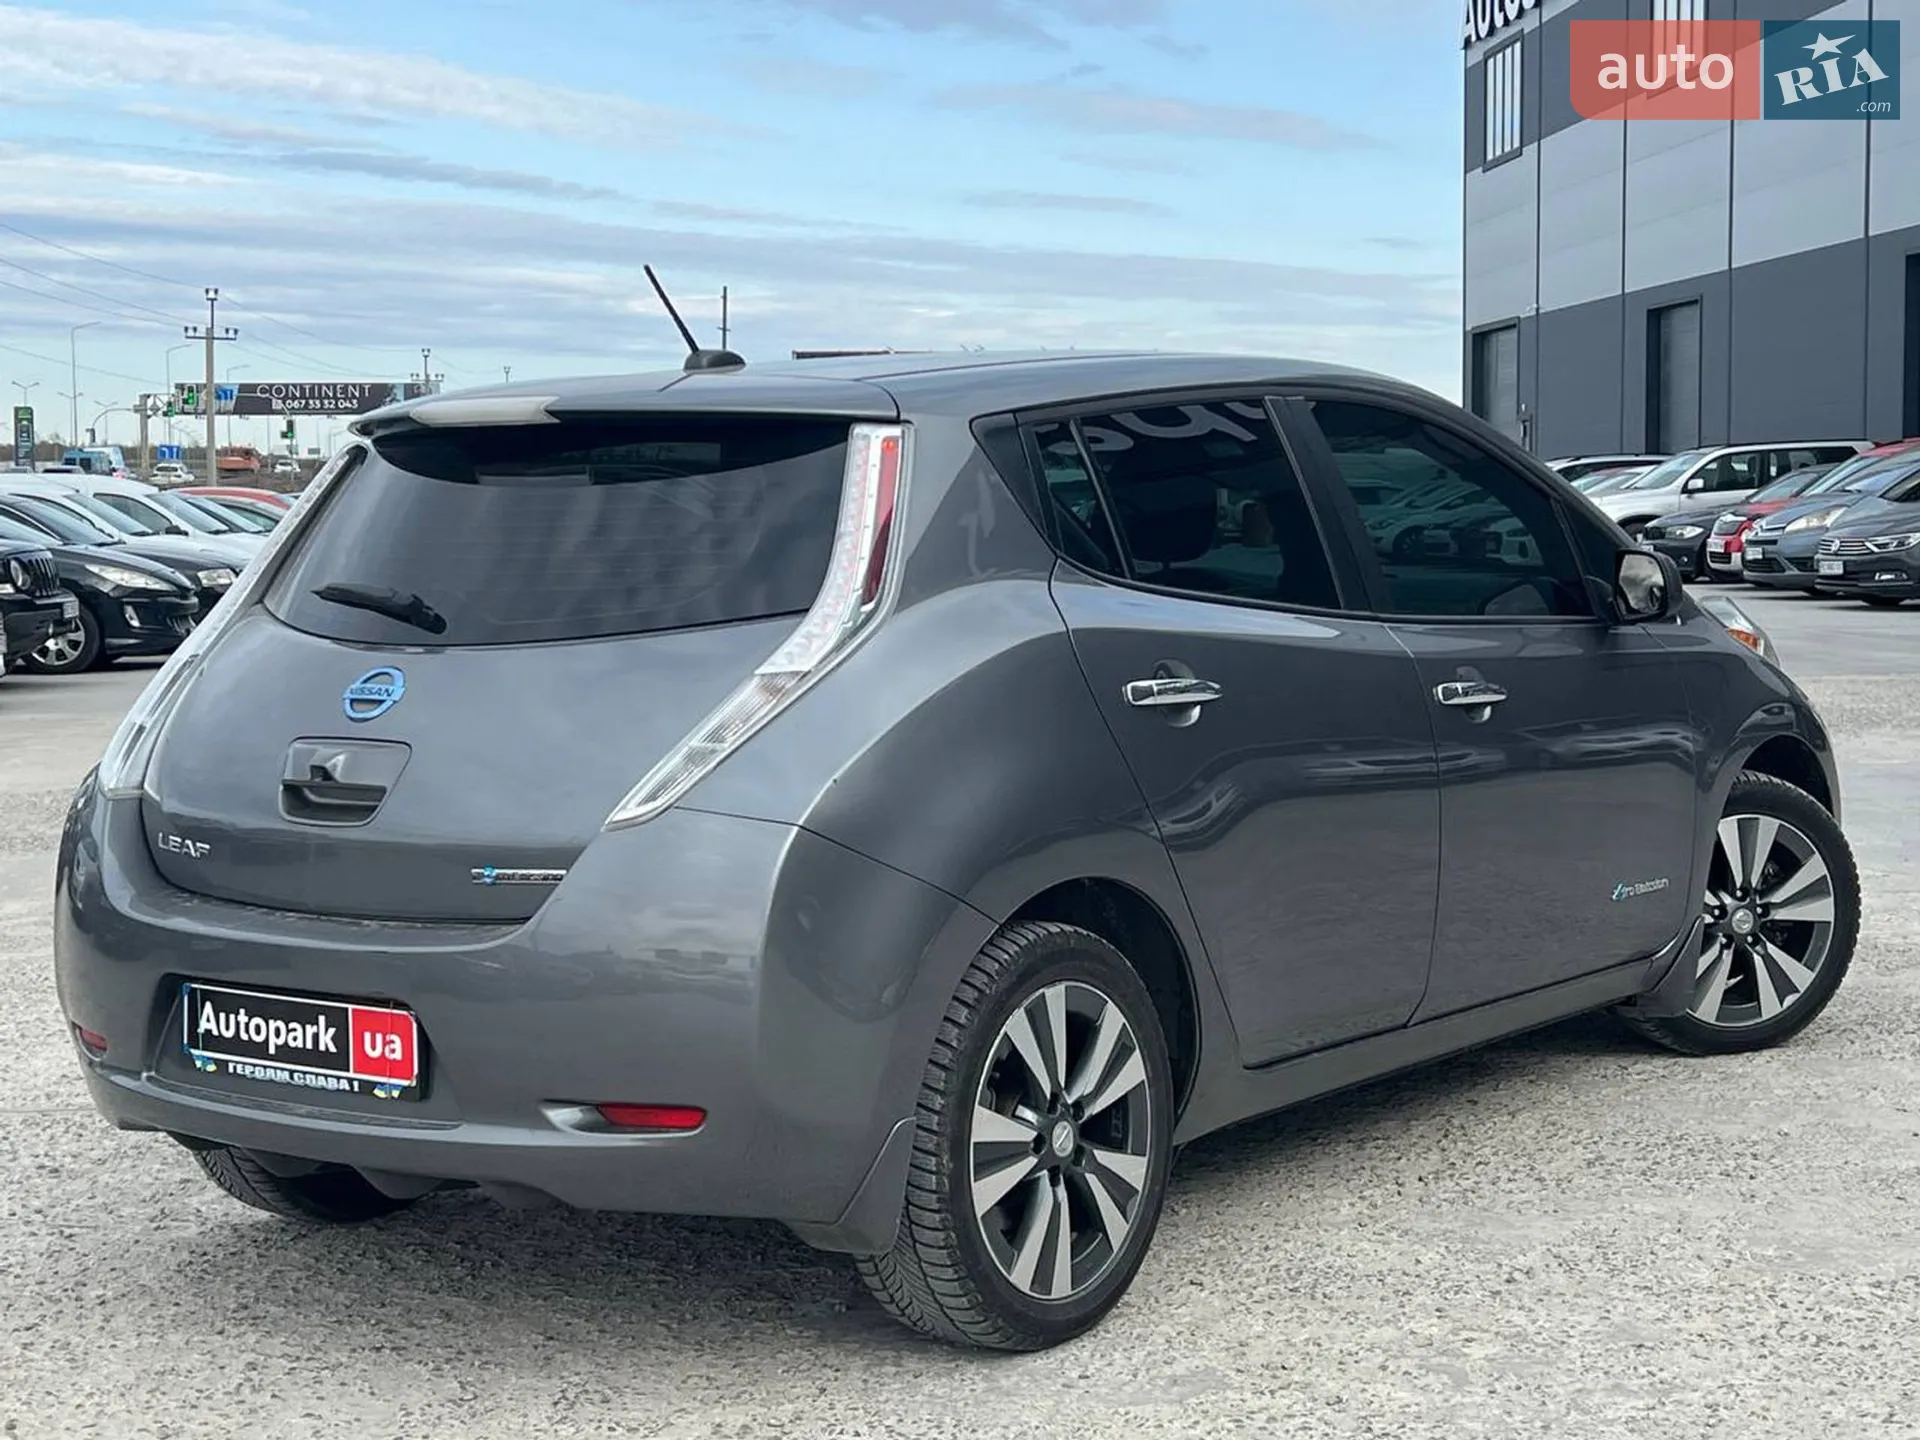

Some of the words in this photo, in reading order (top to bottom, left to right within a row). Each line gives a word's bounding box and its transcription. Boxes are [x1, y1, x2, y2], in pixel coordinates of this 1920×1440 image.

[257, 384, 372, 398] CONTINENT
[285, 399, 306, 409] 067
[158, 832, 211, 858] LEAF
[199, 1001, 337, 1054] Autopark
[364, 1032, 403, 1060] ua
